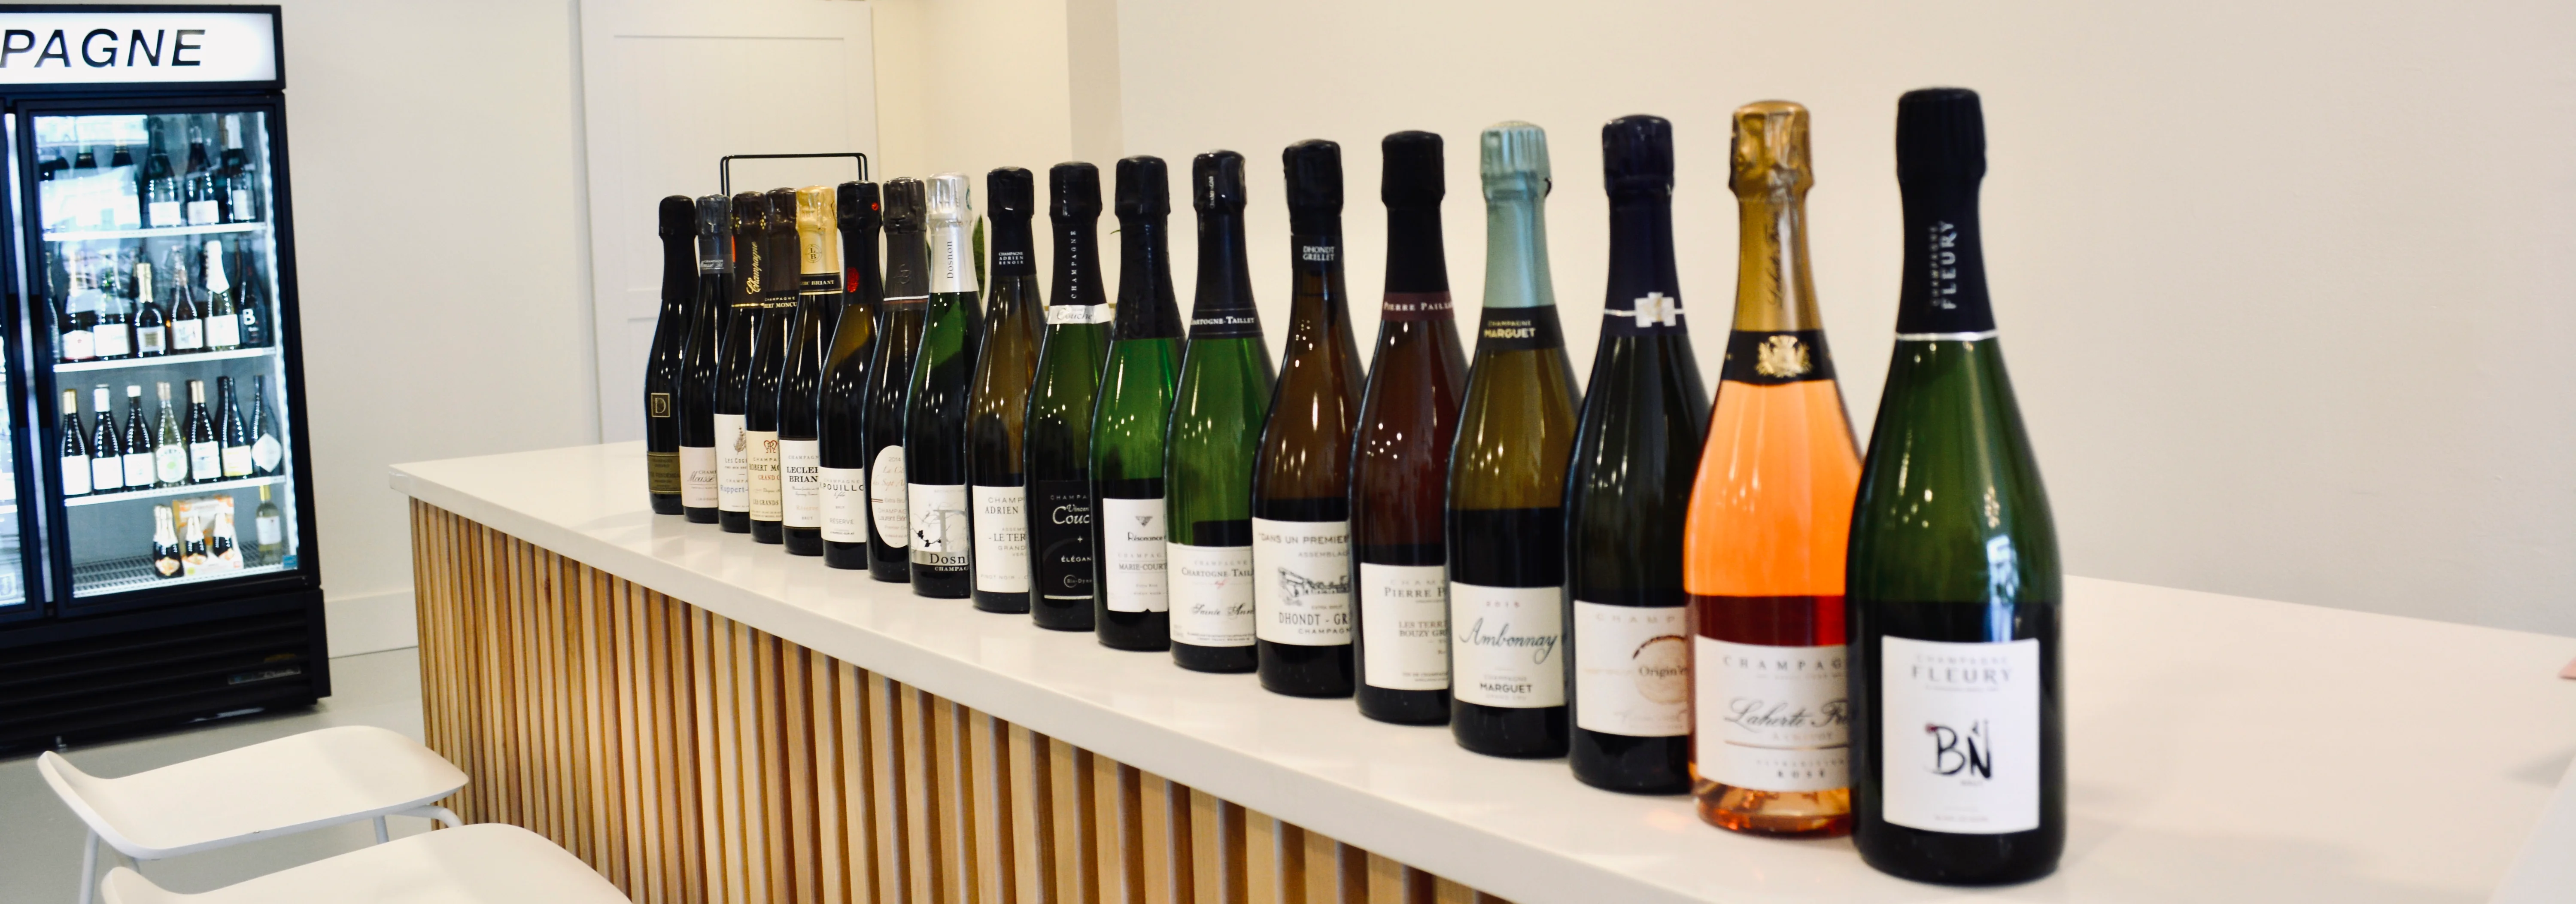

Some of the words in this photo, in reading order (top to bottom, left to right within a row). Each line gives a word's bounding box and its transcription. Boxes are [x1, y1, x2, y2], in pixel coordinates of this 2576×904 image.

[0, 28, 206, 68] PAGNE
[746, 241, 762, 295] Champagne
[1939, 220, 1957, 309] FLEURY
[1384, 301, 1415, 311] PIERRE
[1484, 328, 1536, 338] MARGUET
[984, 506, 1019, 514] ADRIEN
[994, 533, 1005, 542] LE
[930, 553, 966, 564] Dosn
[1384, 587, 1432, 597] PIERRE
[1190, 603, 1221, 615] Sainte
[1279, 612, 1321, 626] DHONDT
[1595, 613, 1675, 623] CHAMP
[1459, 617, 1558, 665] Ambonnay
[1723, 654, 1842, 670] CHAMPAG
[1916, 655, 2008, 665] CHAMPAGNE
[1911, 664, 2012, 685] FLEURY
[1480, 683, 1532, 693] MARGUET
[1723, 696, 1813, 734] Laherte
[1923, 718, 1992, 780] BN
